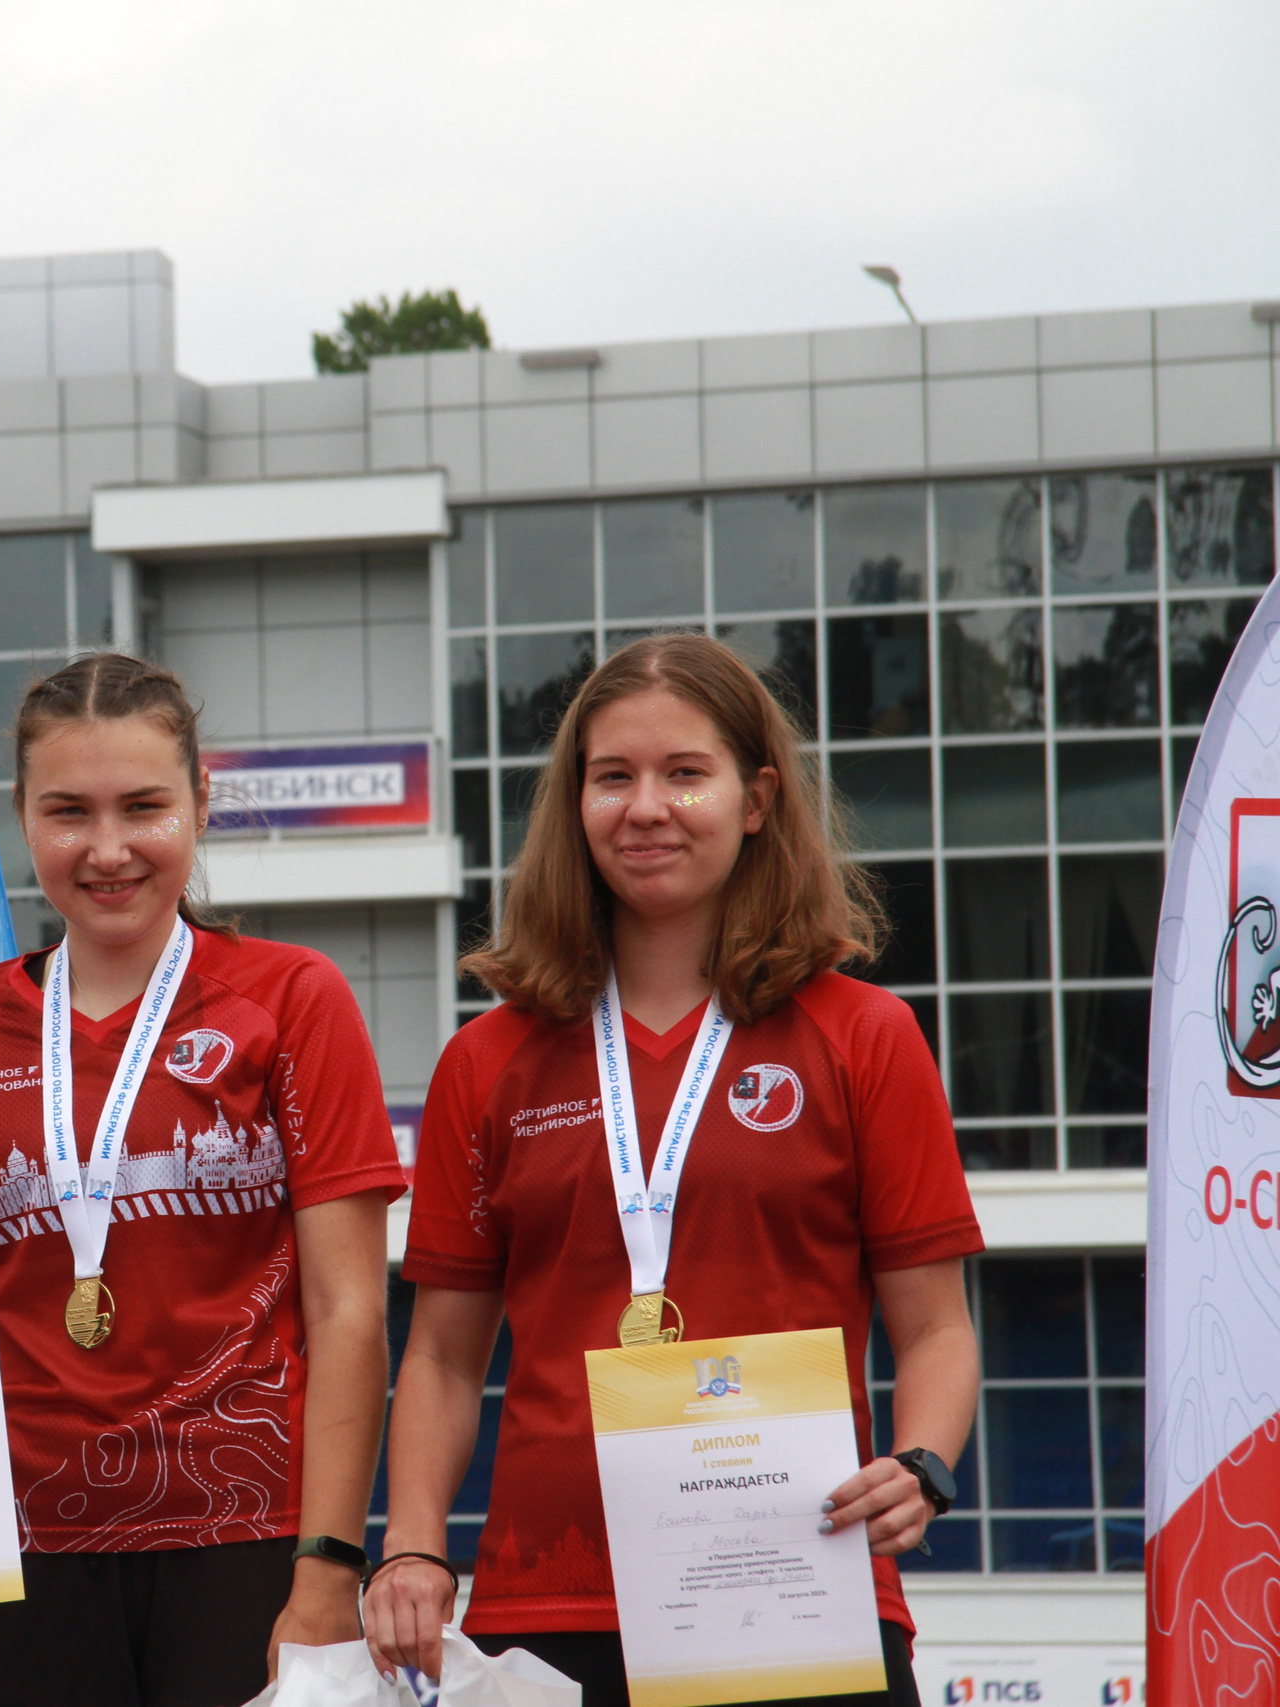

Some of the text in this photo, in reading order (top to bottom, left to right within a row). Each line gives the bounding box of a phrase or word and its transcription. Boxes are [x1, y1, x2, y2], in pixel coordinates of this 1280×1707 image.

[50, 974, 61, 1038] РОССИЙСКОЙ
[145, 985, 167, 1023] СПОРТА
[52, 1039, 61, 1078] СПОРТА
[120, 1024, 152, 1091] РОССИЙСКОЙ
[600, 988, 631, 1174] МИНИСТЕРСТВО СПОРТА РОССИЙС
[663, 1027, 720, 1171] РОССИЙСКОЙ ФЕДЕРАЦИИ
[53, 1079, 67, 1161] МИНИСТЕРСТВО
[101, 1091, 126, 1160] ФЕДЕРАЦИИ
[510, 1100, 587, 1127] СОРТИВНОЕ
[692, 1433, 760, 1454] ДИПЛОМ
[710, 1457, 753, 1468] степени
[680, 1472, 789, 1493] НАГРАЖДАЕТСЯ
[709, 1531, 764, 1548] Москва
[697, 1562, 742, 1572] спортивному
[743, 1556, 803, 1568] ориентированию
[714, 1551, 753, 1560] Первенстве
[755, 1549, 779, 1557] России
[747, 1567, 774, 1577] эстафета
[787, 1591, 809, 1599] августа
[983, 1680, 1042, 1701] ПСБ
